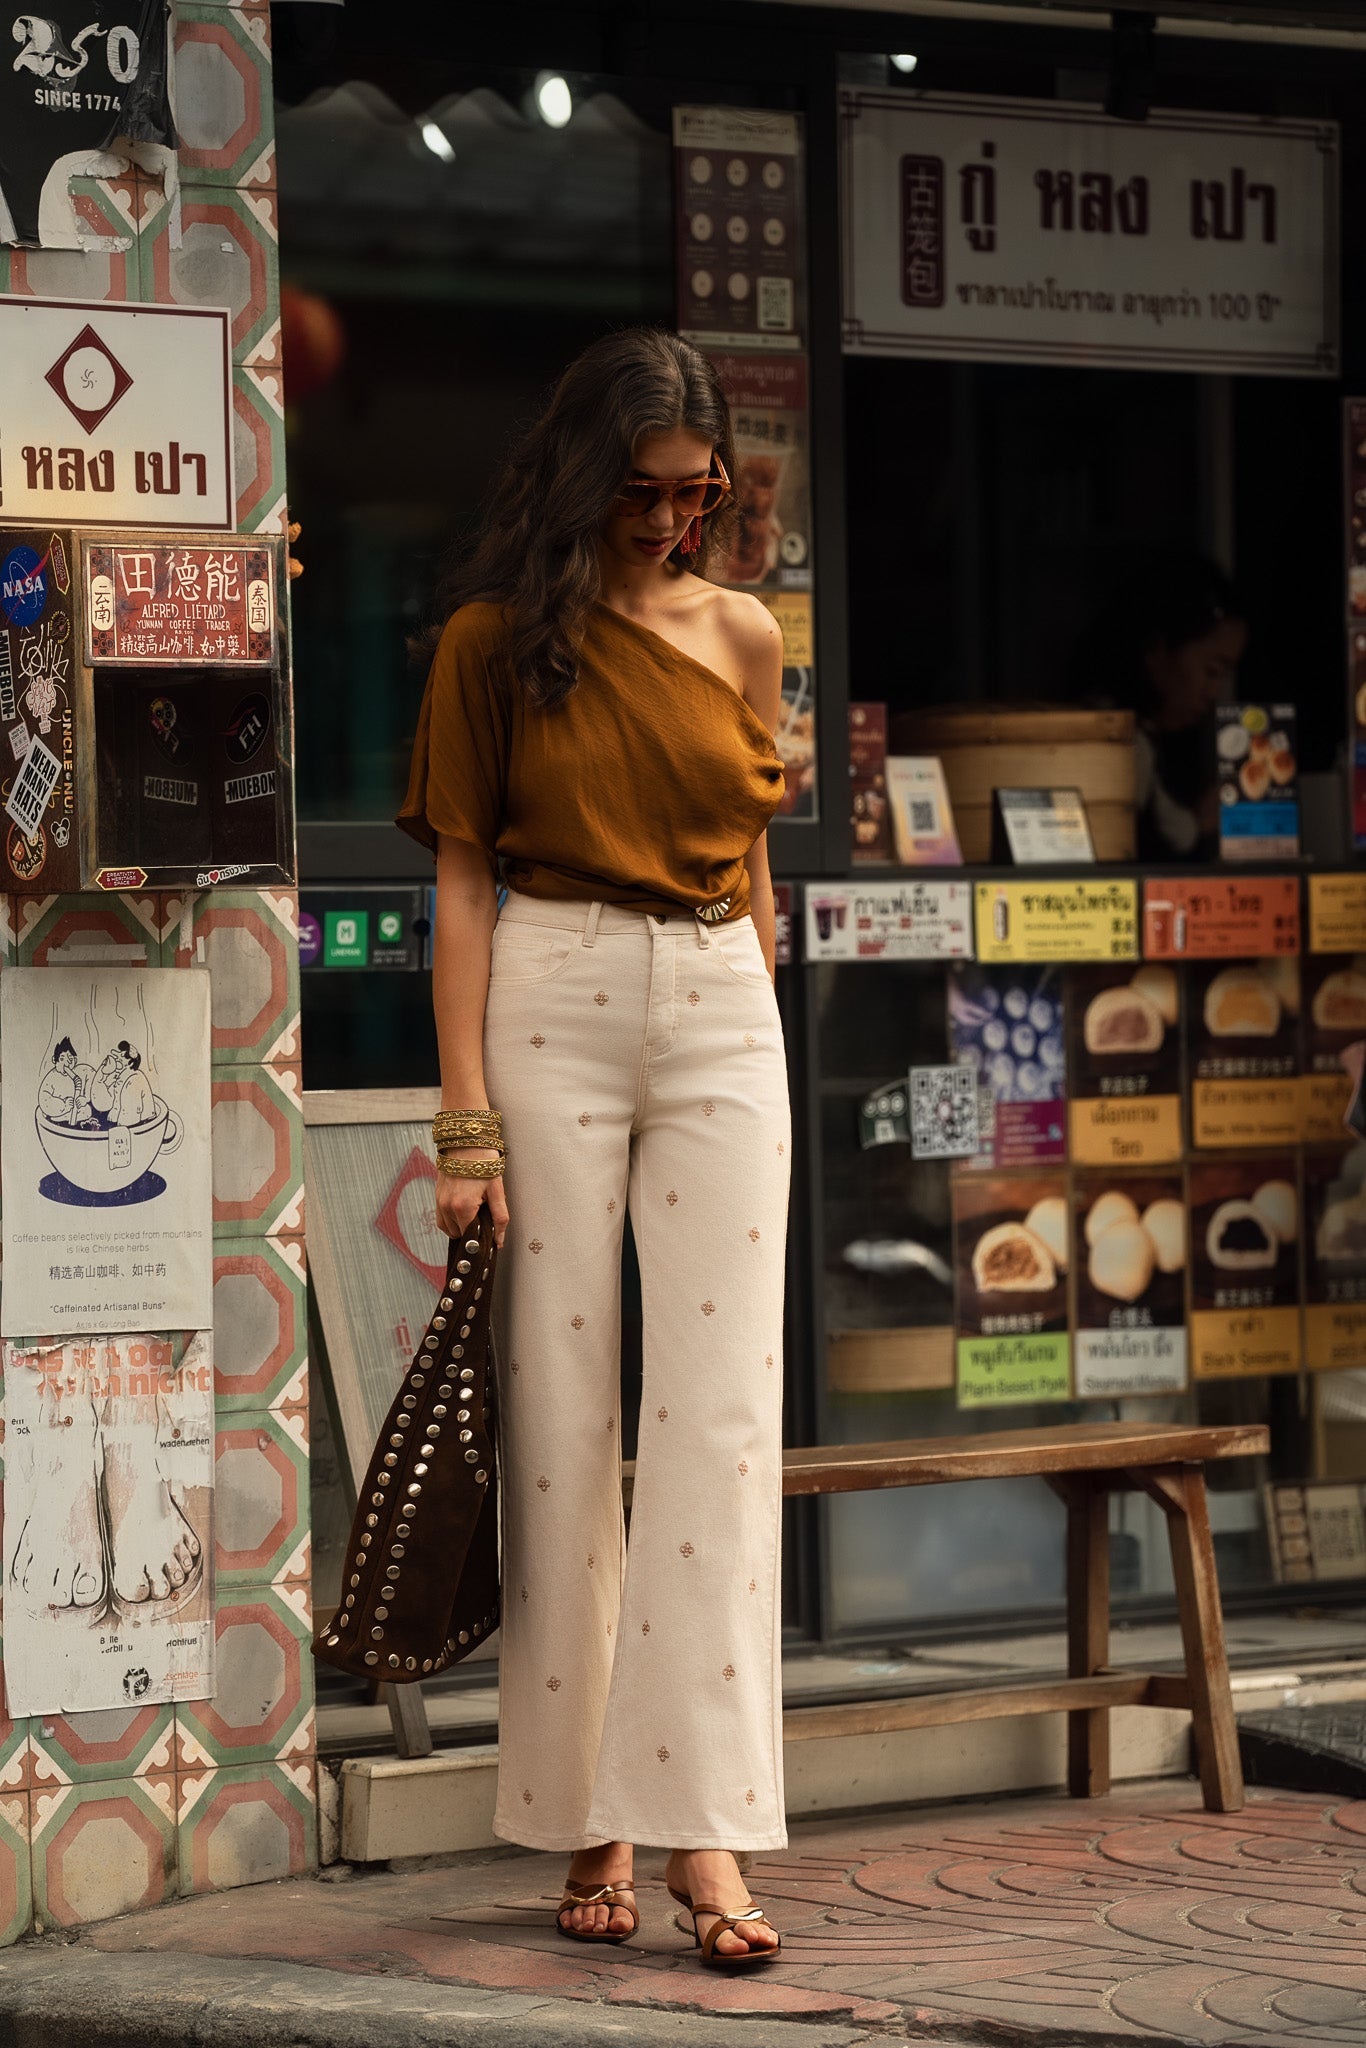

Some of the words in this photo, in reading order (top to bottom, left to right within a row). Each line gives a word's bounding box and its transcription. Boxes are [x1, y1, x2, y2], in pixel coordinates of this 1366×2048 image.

[12, 15, 139, 84] 250
[34, 88, 81, 110] SINCE
[85, 93, 121, 112] 1774
[1034, 168, 1149, 236] หลง
[1190, 167, 1277, 244] เปา
[21, 446, 115, 492] หลง
[134, 441, 207, 496] เปา
[3, 575, 45, 598] NASA
[94, 585, 111, 623] 云南
[251, 584, 267, 626] 泰国
[137, 620, 163, 630] YUNNAN
[169, 620, 196, 630] COFFEE
[205, 620, 231, 631] TRADER
[142, 603, 179, 618] ALFRED
[62, 709, 73, 771] UNCLE
[23, 764, 50, 801] MANY
[30, 745, 57, 784] WEAR
[14, 782, 43, 823] HATS
[12, 1234, 39, 1243] Coffee
[41, 1233, 66, 1242] beans
[68, 1232, 111, 1242] selectively
[114, 1231, 140, 1241] picked
[142, 1231, 160, 1240] from
[162, 1229, 202, 1239] mountains
[75, 1245, 90, 1254] like
[92, 1243, 124, 1253] Chinese
[103, 1302, 140, 1312] Artisanal
